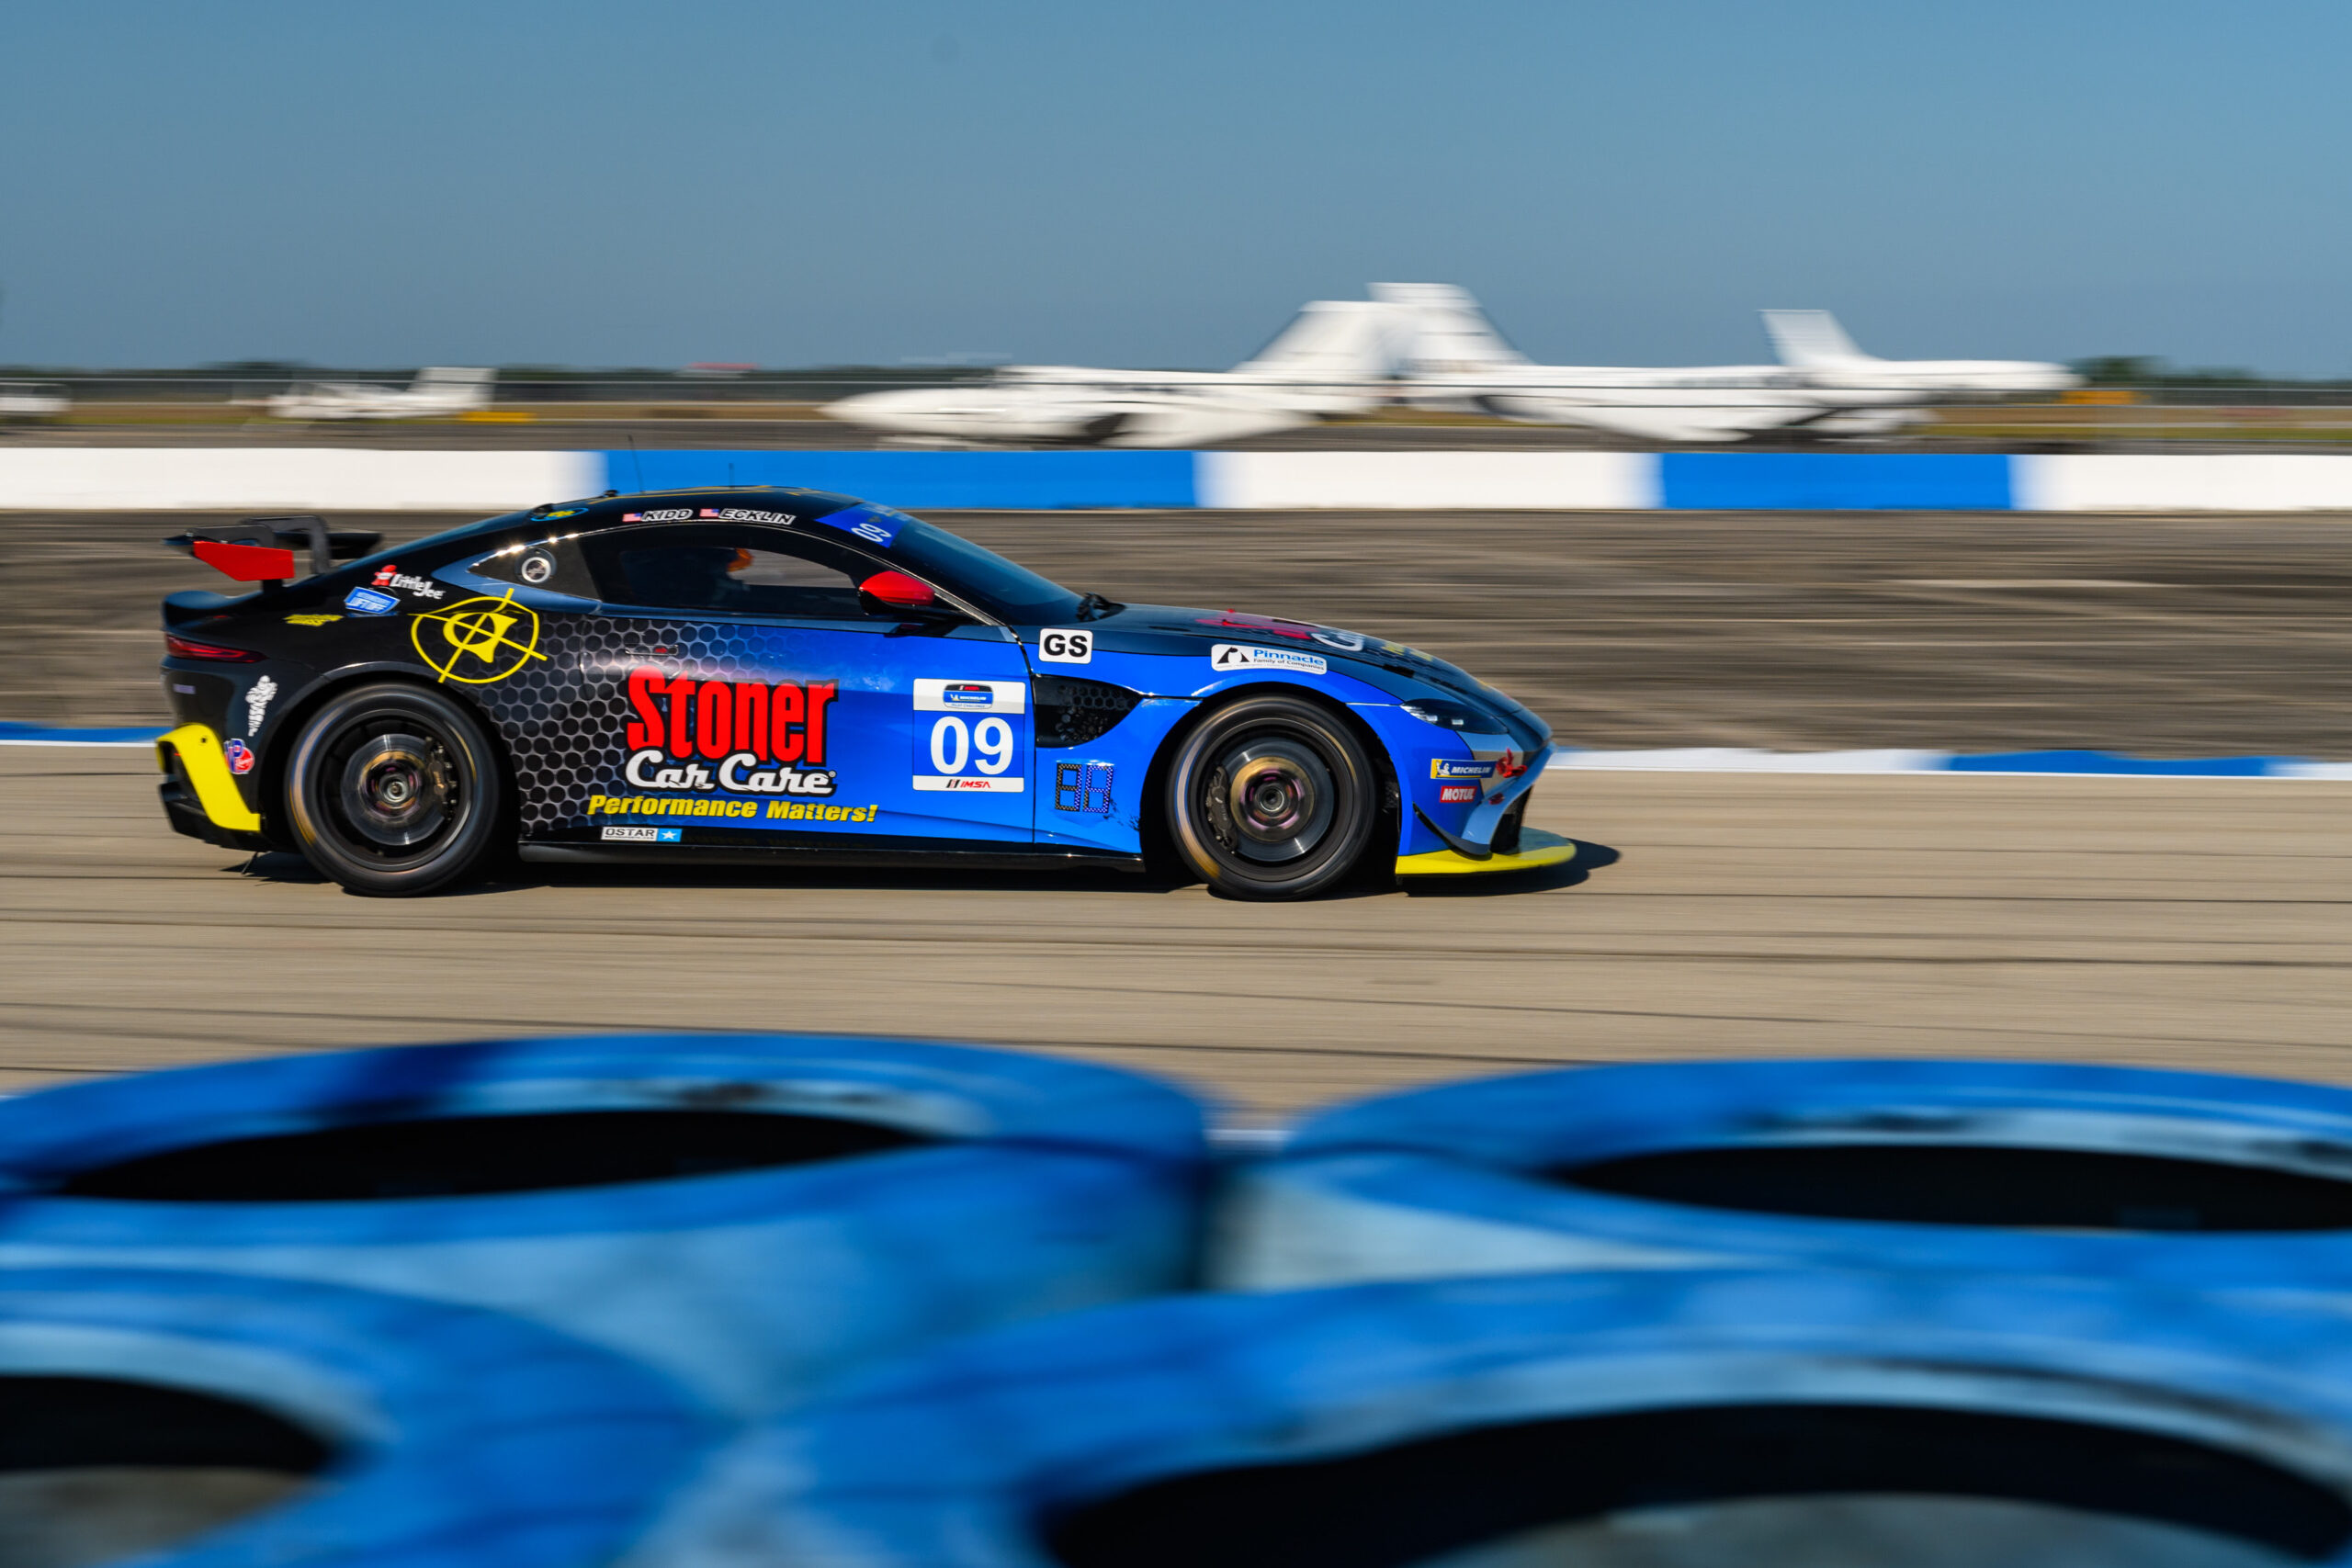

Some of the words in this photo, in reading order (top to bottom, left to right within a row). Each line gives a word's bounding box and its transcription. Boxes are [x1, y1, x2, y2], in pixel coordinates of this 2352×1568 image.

[641, 509, 694, 522] KIDD
[718, 508, 797, 525] ECKLIN
[851, 523, 892, 542] 09
[1044, 634, 1088, 658] GS
[1253, 649, 1324, 666] Pinnacle
[1287, 660, 1325, 671] Companies
[627, 664, 835, 763] Stoner
[931, 716, 1014, 775] 09
[626, 750, 715, 790] Car
[1451, 766, 1492, 774] MICHELIN
[1442, 788, 1476, 801] MOTUL
[586, 795, 758, 818] Performance
[766, 800, 878, 823] Matters!
[605, 829, 655, 837] OSTAR
